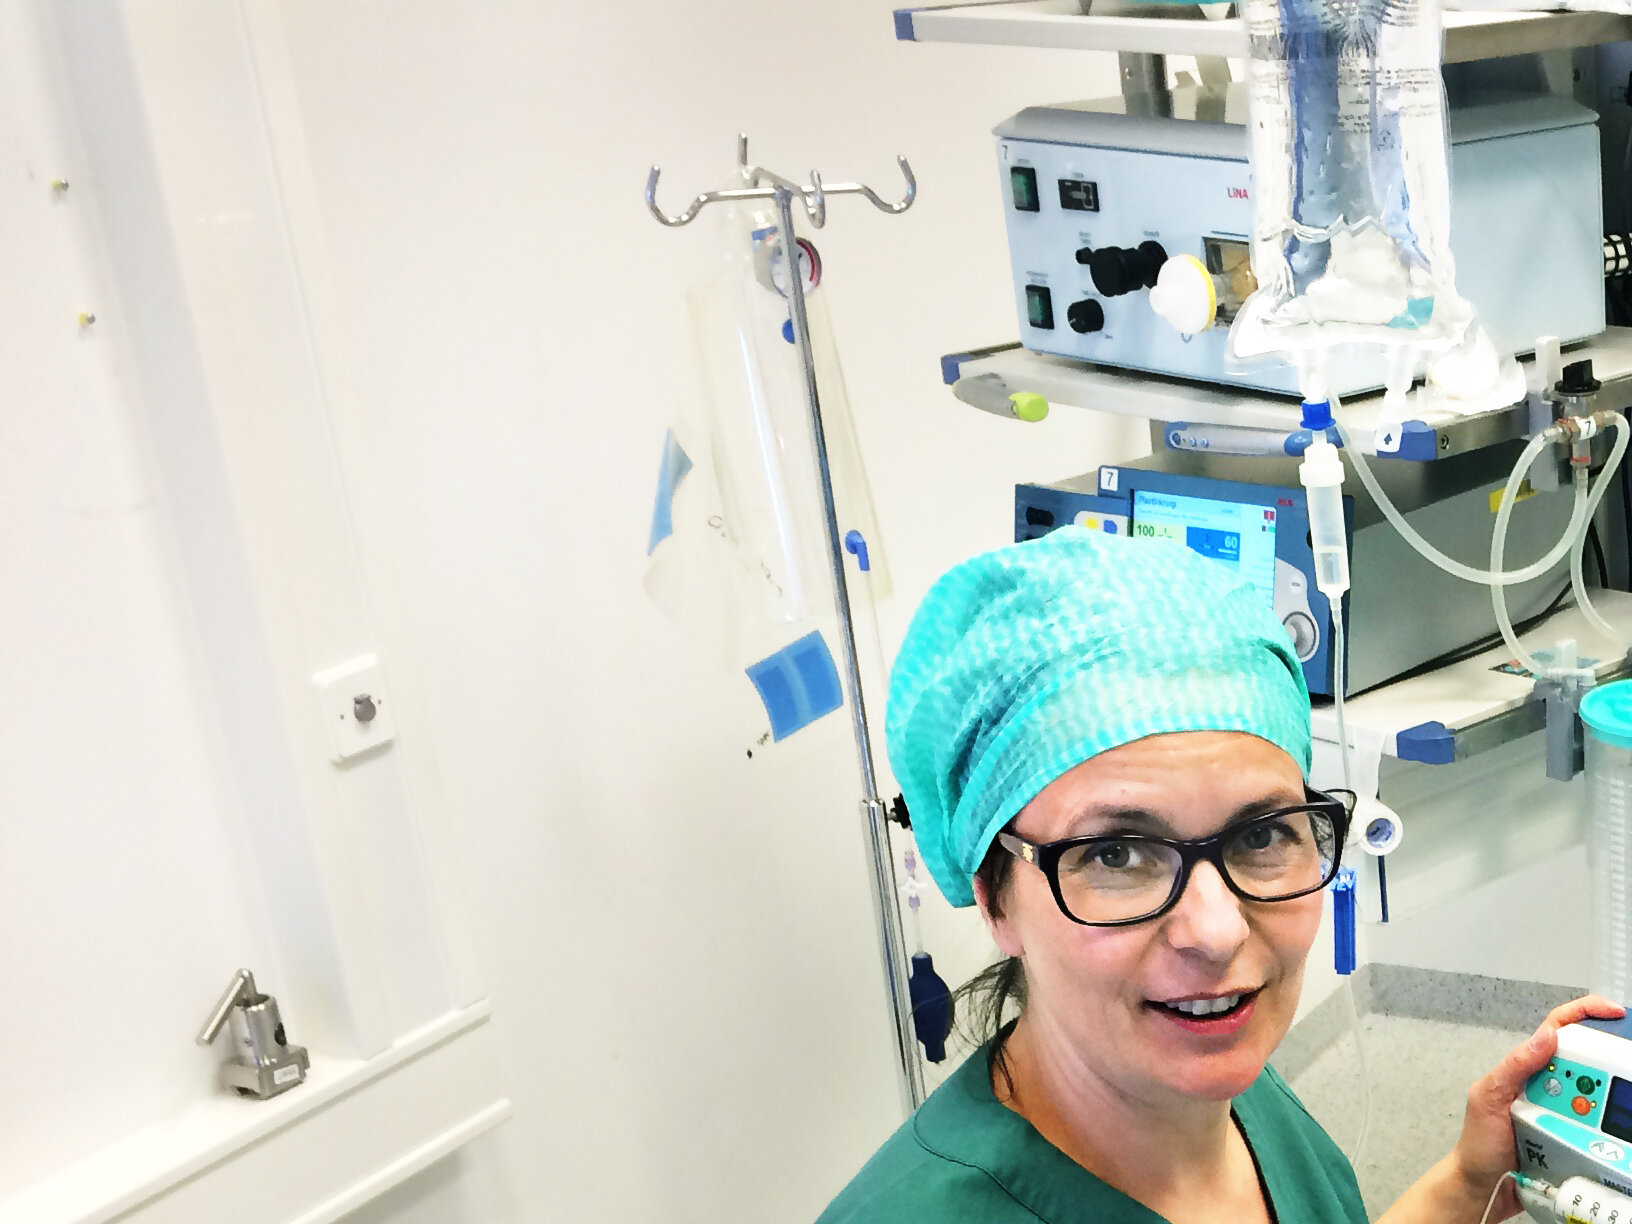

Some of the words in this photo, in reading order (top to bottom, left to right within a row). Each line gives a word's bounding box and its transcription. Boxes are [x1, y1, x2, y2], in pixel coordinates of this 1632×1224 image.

[1584, 420, 1592, 436] 7
[1106, 470, 1114, 487] 7
[1136, 524, 1155, 538] 100
[1224, 535, 1238, 549] 60
[1526, 1147, 1549, 1170] PK
[1571, 1193, 1583, 1208] 10
[1589, 1200, 1601, 1218] 20
